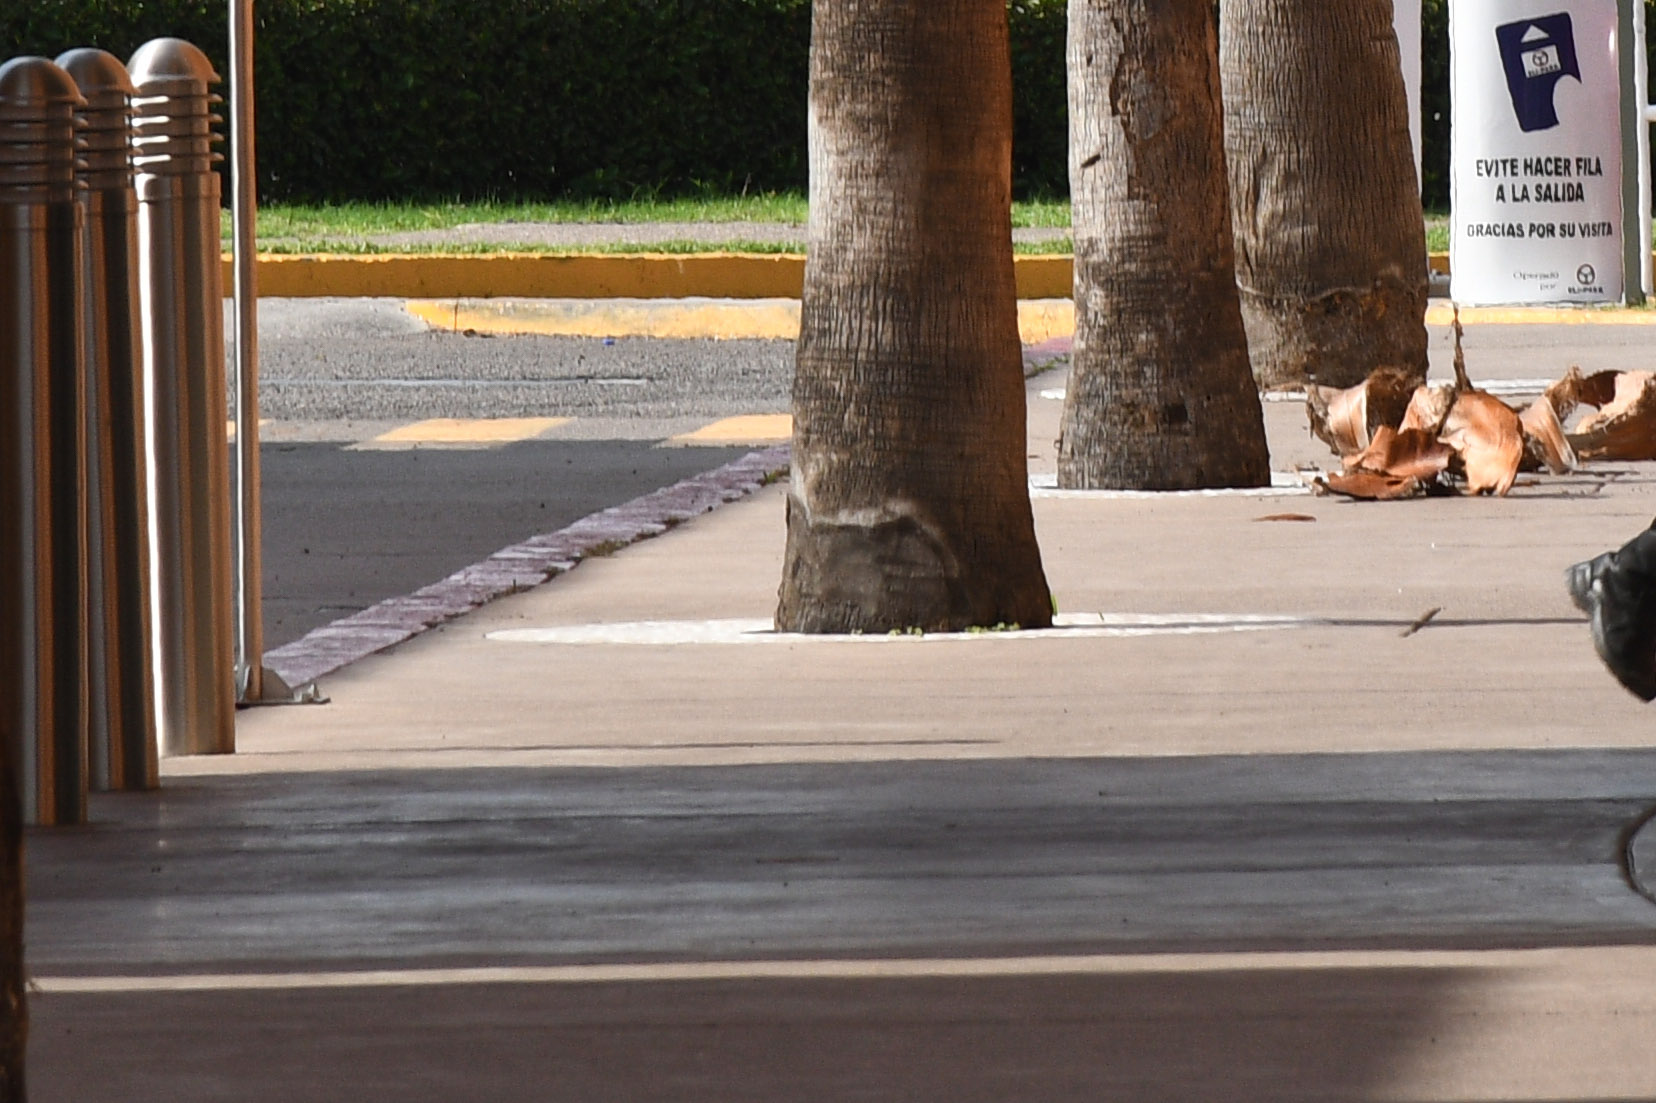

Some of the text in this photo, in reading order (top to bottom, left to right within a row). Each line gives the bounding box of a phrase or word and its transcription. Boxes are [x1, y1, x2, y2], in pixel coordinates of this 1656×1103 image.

[1476, 157, 1603, 178] EVITE HACER FILA
[1496, 182, 1585, 203] A LA SALIDA
[1528, 223, 1556, 238] POR
[1559, 222, 1576, 238] SU
[1578, 221, 1613, 238] VISITA
